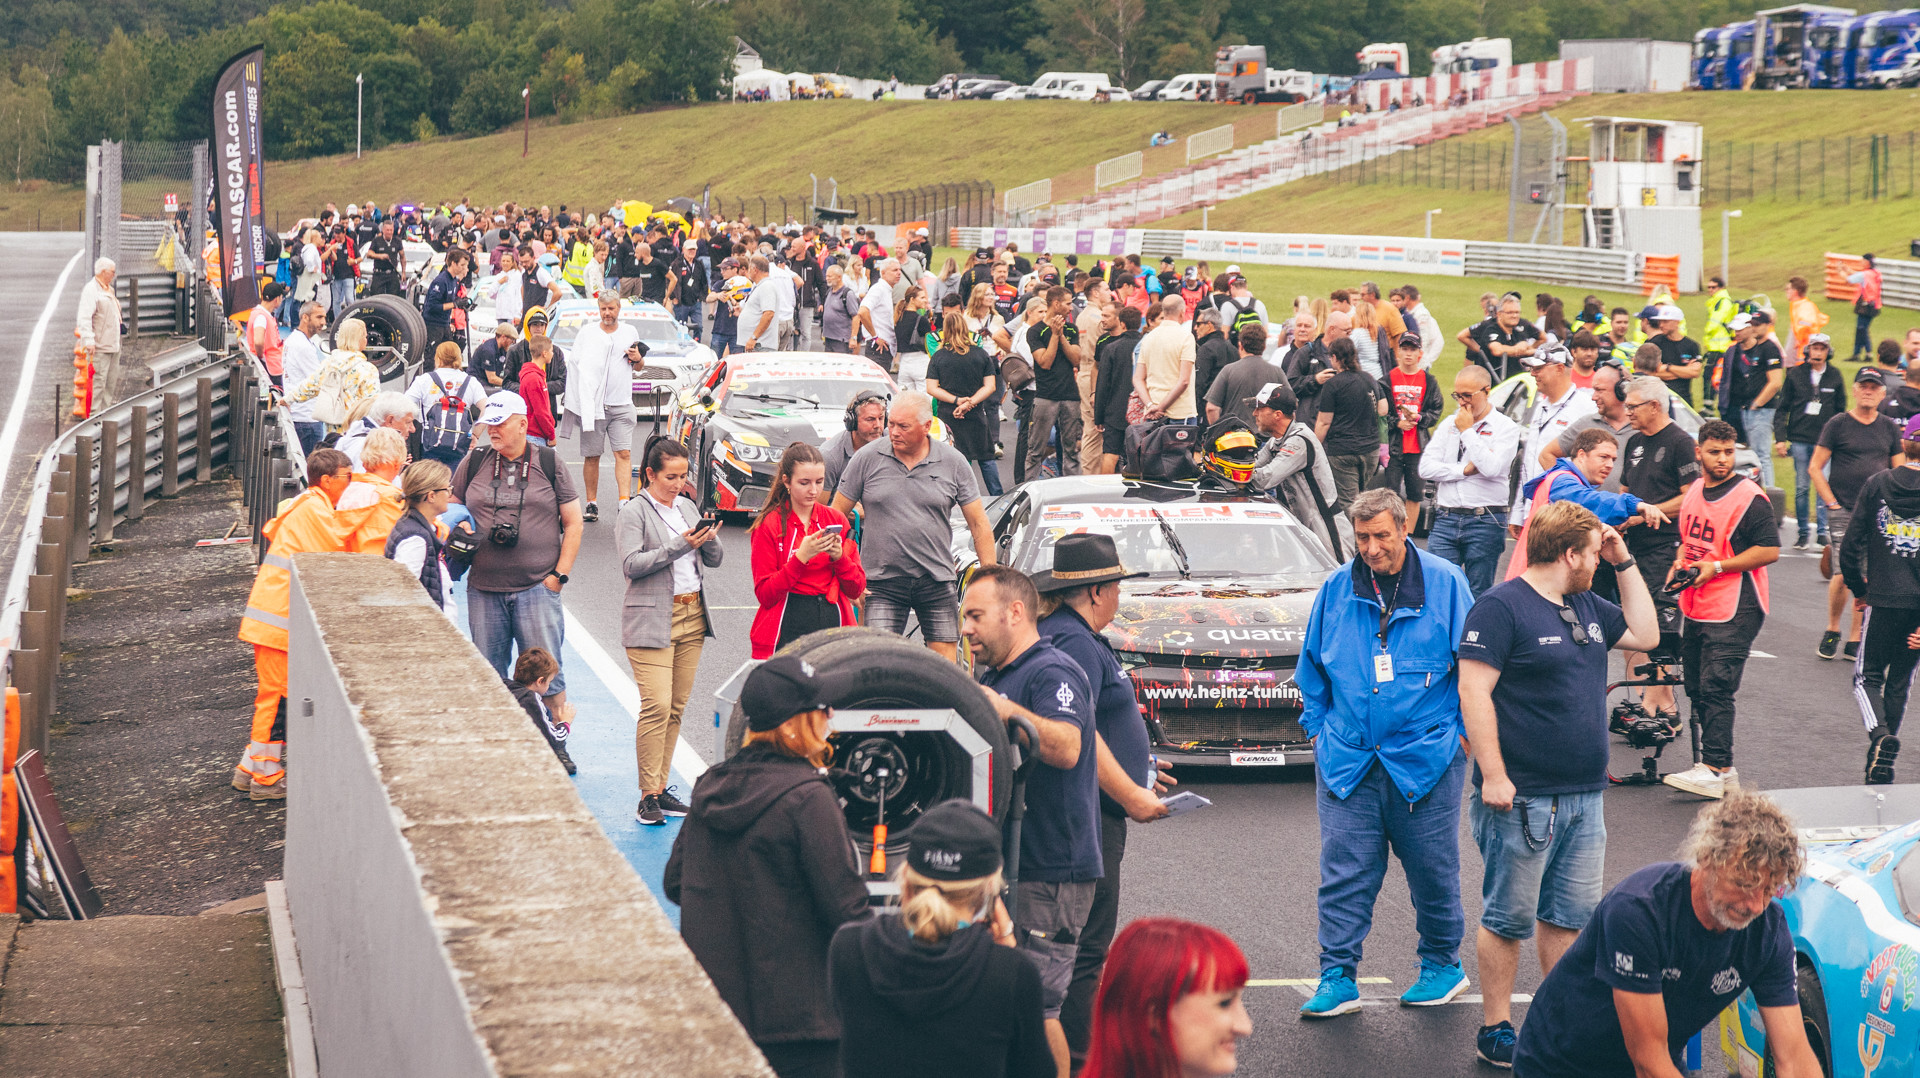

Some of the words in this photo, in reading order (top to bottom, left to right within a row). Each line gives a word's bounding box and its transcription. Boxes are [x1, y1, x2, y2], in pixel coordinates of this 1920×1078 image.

[165, 194, 177, 205] 11
[252, 225, 264, 263] NASCAR
[1236, 755, 1279, 763] KENNOL
